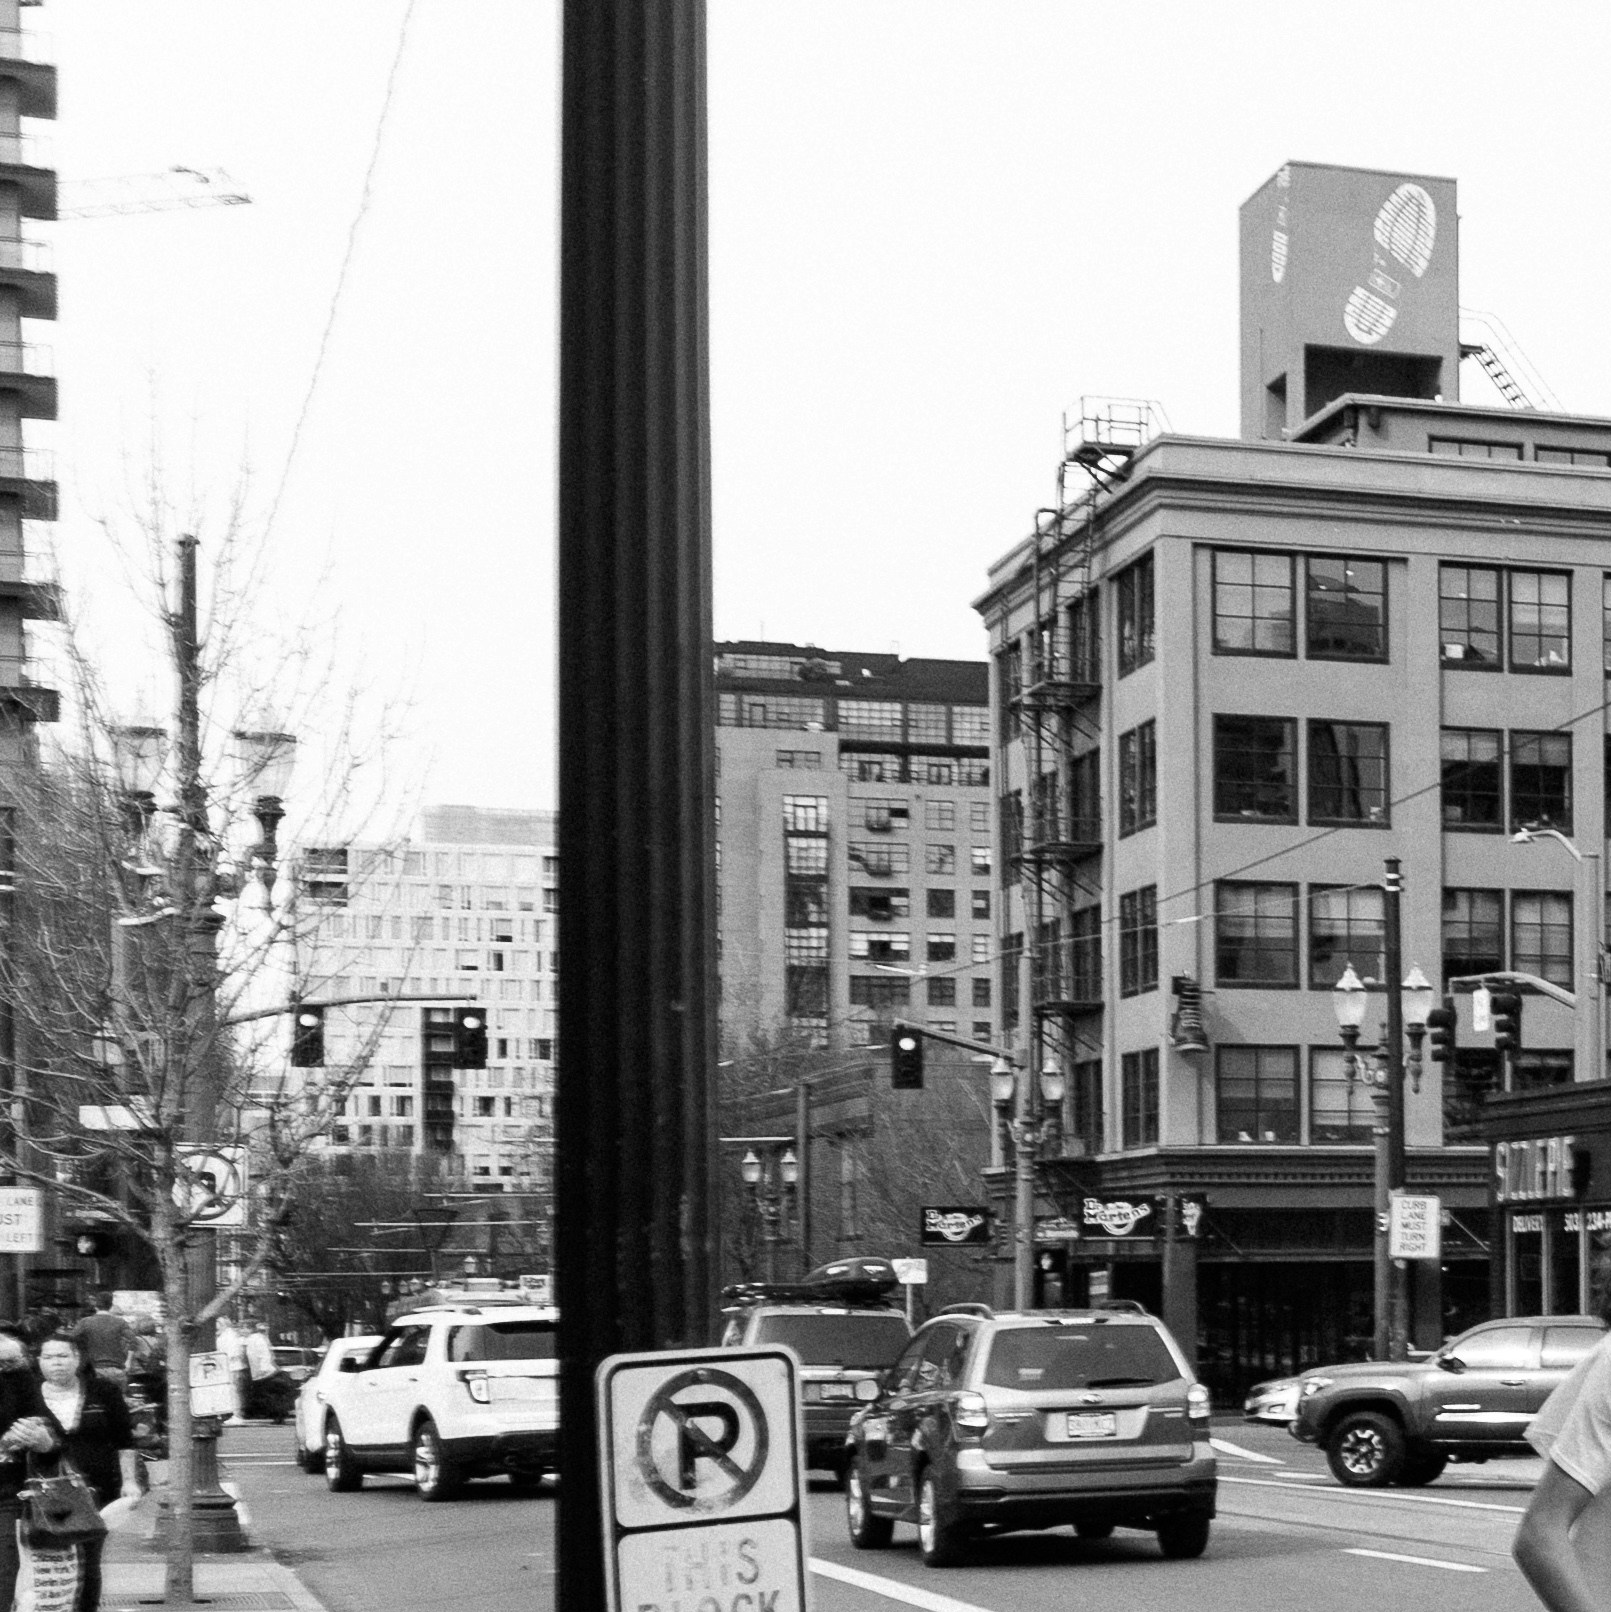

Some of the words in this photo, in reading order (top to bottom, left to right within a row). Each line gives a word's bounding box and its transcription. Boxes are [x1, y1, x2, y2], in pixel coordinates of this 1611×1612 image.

[1402, 1200, 1427, 1210] CURB
[0, 1213, 22, 1225] ST
[1084, 1203, 1151, 1225] Martens
[1401, 1212, 1426, 1220] LANE
[1401, 1222, 1427, 1230] MUST
[1400, 1232, 1425, 1240] TURN
[1400, 1242, 1426, 1252] RIGHT
[663, 1537, 760, 1593] THIS
